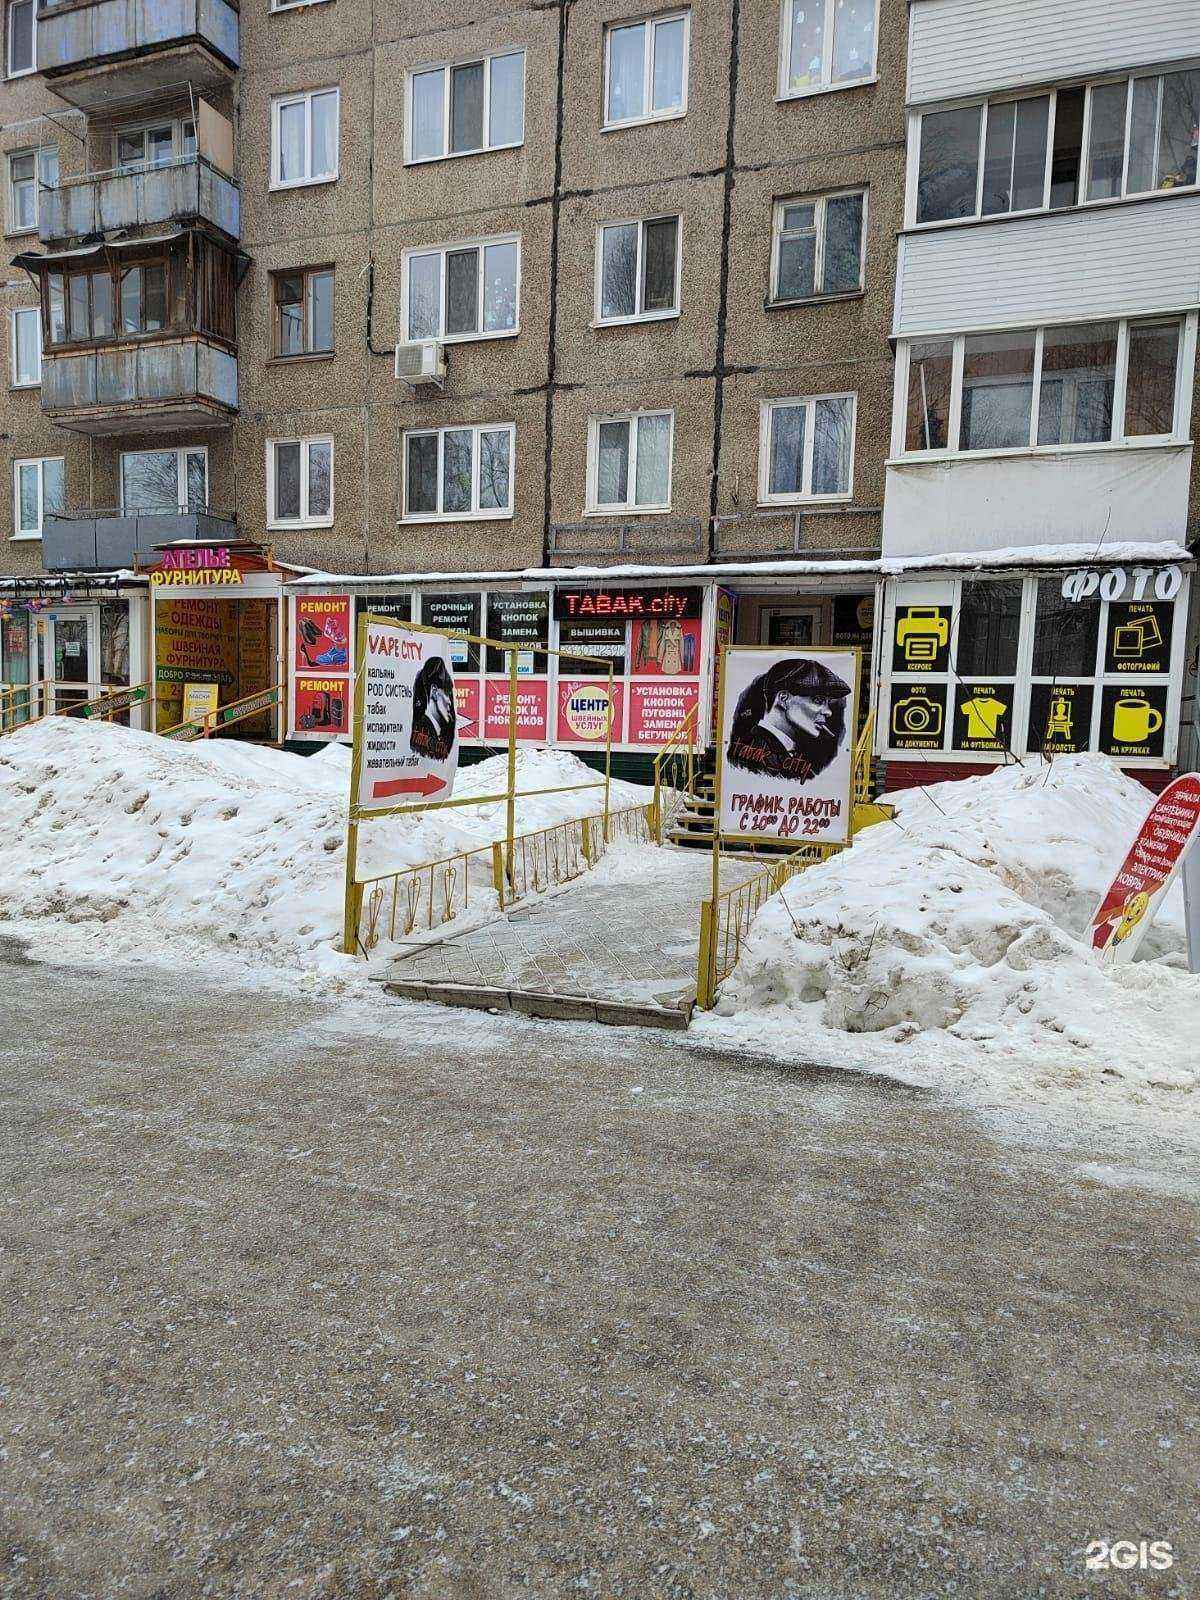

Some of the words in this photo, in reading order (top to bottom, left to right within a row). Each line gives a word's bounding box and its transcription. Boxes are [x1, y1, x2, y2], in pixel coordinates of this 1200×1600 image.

[162, 548, 230, 569] АТЕЛЬЕ
[151, 569, 245, 586] ФУРНИТУРА
[1062, 566, 1183, 603] ФОТО
[300, 602, 347, 613] РЕМОНТ
[367, 604, 402, 613] РЕМОНТ
[430, 602, 474, 612] СРОЧНЫЙ
[493, 601, 547, 610] УСТАНОВКА
[1128, 604, 1153, 613] ПЕЧАТЬ
[432, 615, 468, 623] РЕМОНТ
[501, 613, 539, 622] КНОПОК
[501, 628, 539, 637] ЗАМЕНА
[571, 628, 620, 637] ВЫШИВКА
[368, 635, 399, 658] VAPE
[401, 639, 424, 661] CITY
[907, 663, 932, 671] КСЕРОКС
[158, 670, 184, 680] ДОБРО
[300, 680, 345, 691] РЕМОНТ
[636, 687, 692, 696] УСТАНОВКА
[973, 686, 996, 695] ПЕЧАТЬ
[1120, 688, 1145, 697] ПЕЧАТЬ
[496, 694, 536, 704] РЕОНТ
[643, 698, 684, 707] КНОПОК
[530, 705, 537, 715] И
[571, 699, 609, 712] ЦЕНТР
[642, 708, 687, 719] ПУГОВИЦ
[488, 715, 544, 726] РЮКАКОВ
[643, 720, 684, 729] ЗАМЕНА
[576, 721, 604, 730] УСЛУГ
[905, 740, 939, 748] ДОКУМЕНТЫ
[1111, 745, 1119, 754] НА
[731, 794, 785, 814] ГРАФИК
[788, 797, 841, 818] РАБОТЫ
[778, 815, 800, 837] ДО
[1118, 871, 1144, 891] КОВРЫ
